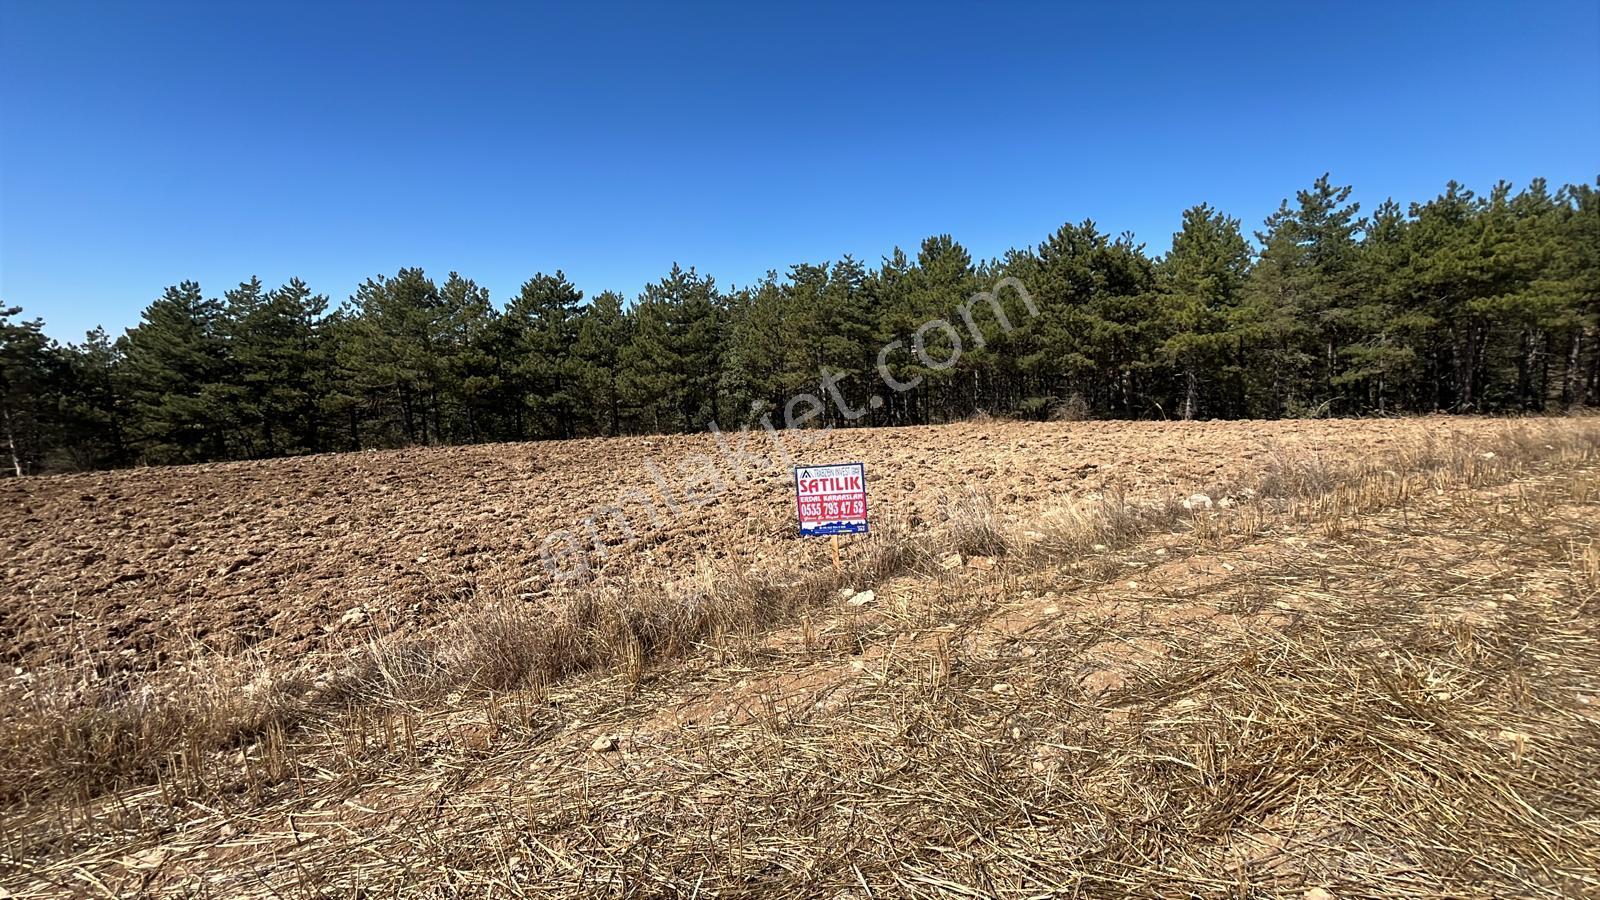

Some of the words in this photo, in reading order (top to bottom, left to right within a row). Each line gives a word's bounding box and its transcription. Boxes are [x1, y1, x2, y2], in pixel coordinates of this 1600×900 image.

[800, 476, 861, 493] SATILIK
[801, 503, 821, 516] 0535
[841, 501, 851, 514] 47
[853, 501, 864, 514] 52
